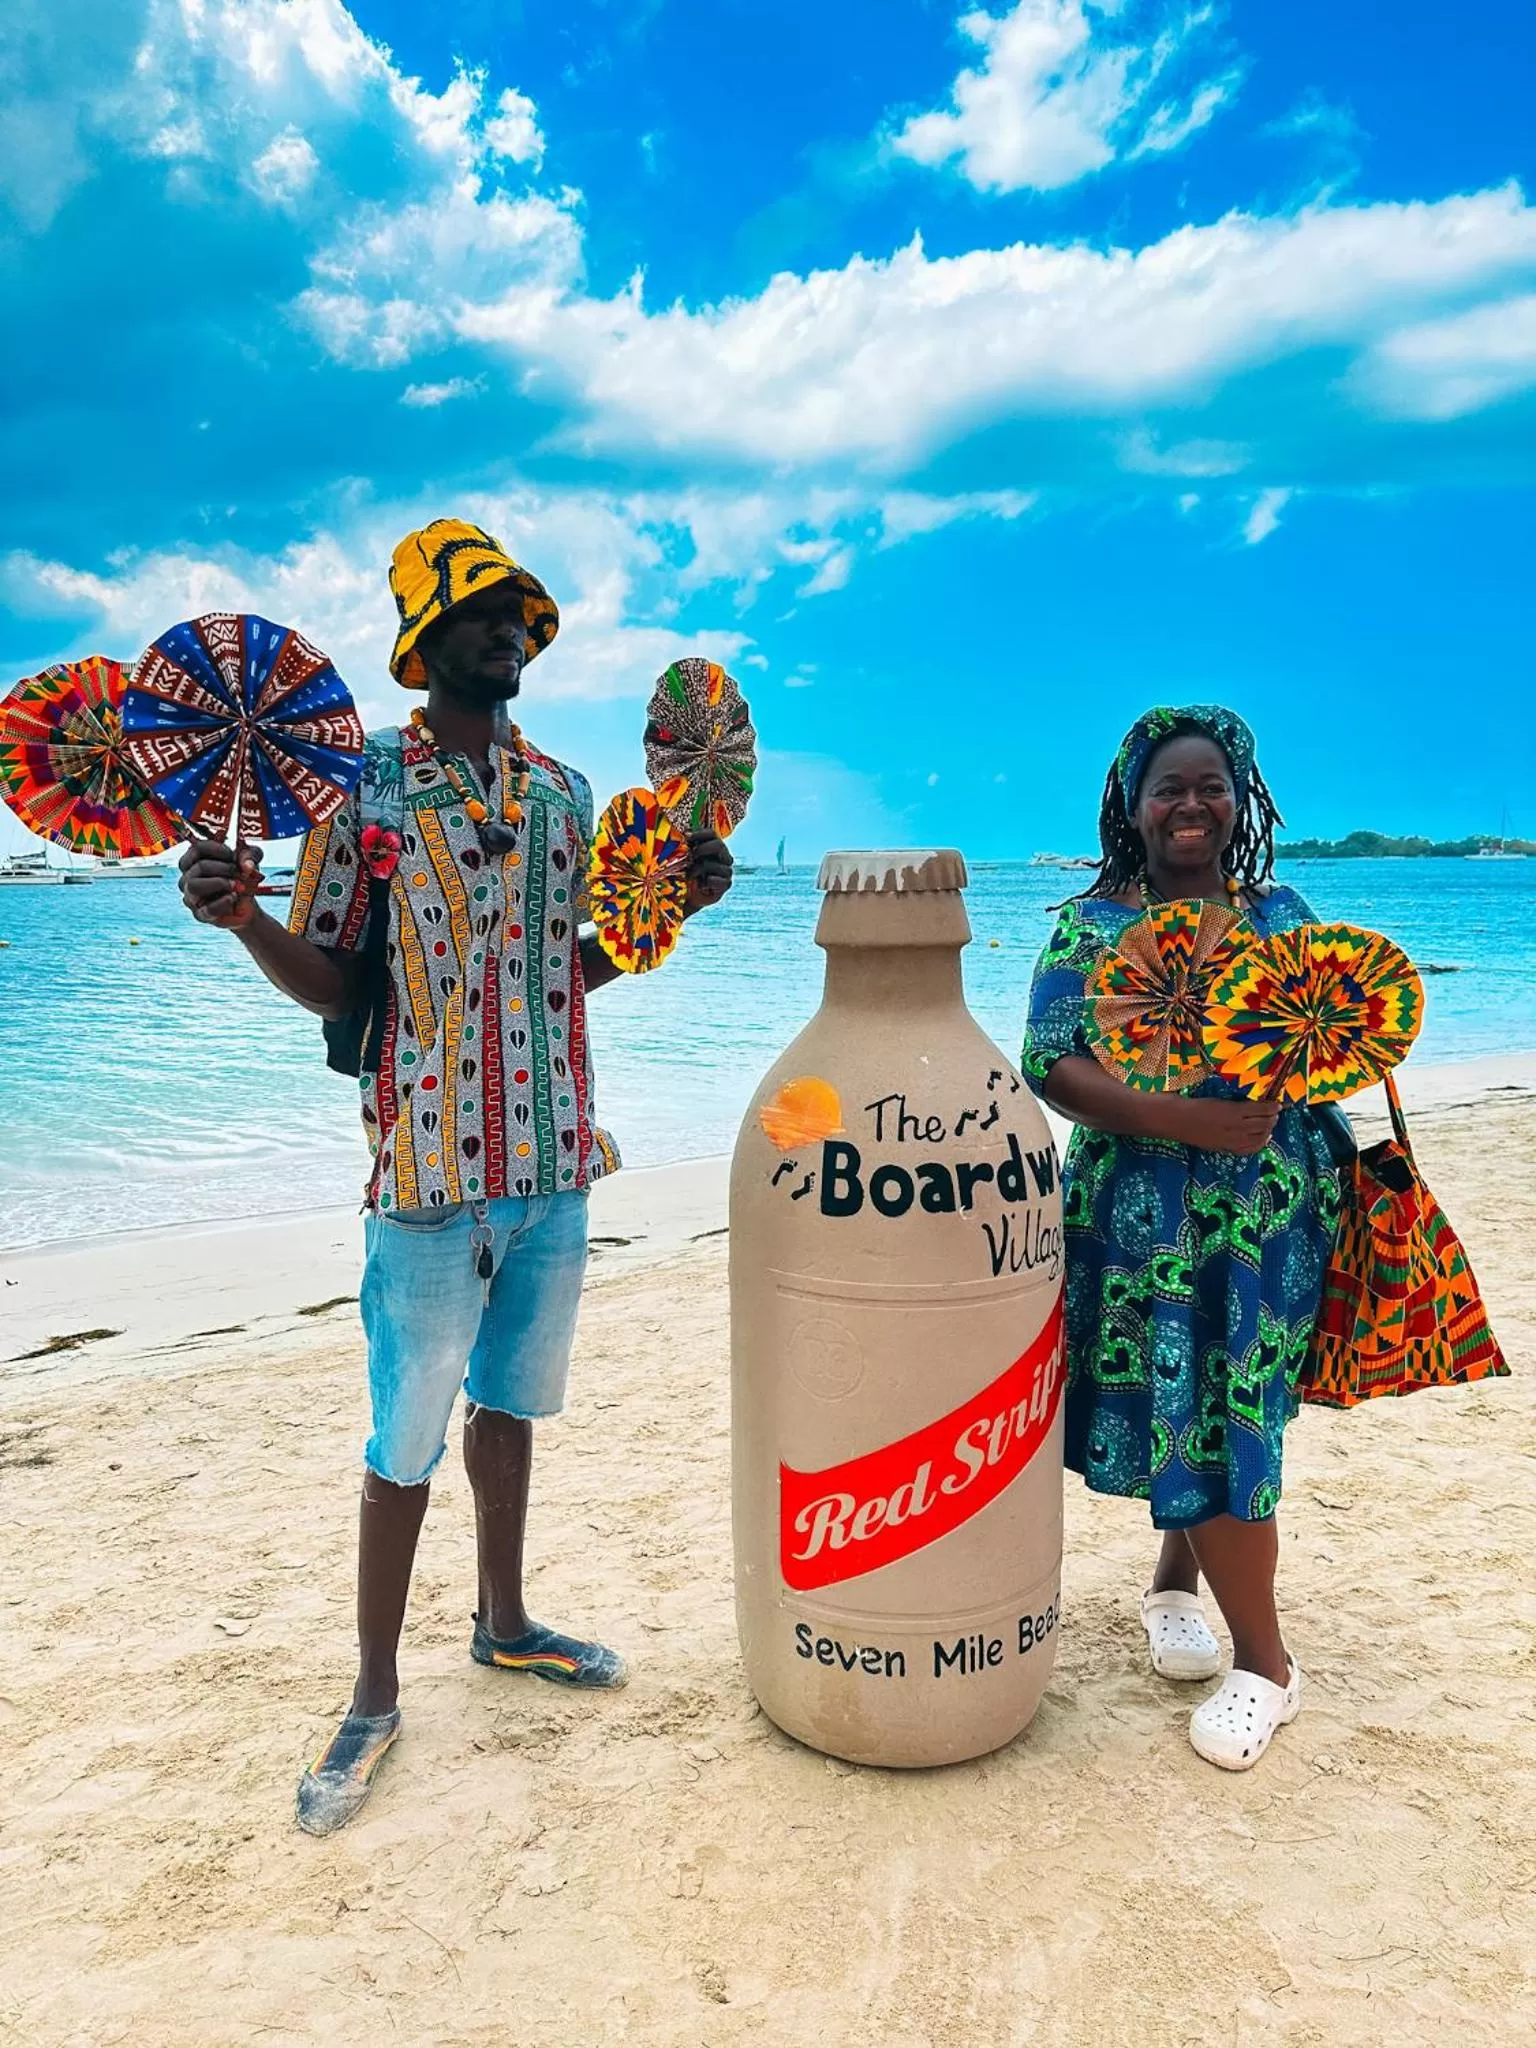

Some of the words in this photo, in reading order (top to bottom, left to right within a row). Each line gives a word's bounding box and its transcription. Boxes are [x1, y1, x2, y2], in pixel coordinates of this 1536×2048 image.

[864, 1093, 946, 1142] The
[820, 1133, 1063, 1217] Boardw
[981, 1207, 1063, 1281] Villag
[791, 1461, 937, 1561] Red
[795, 1623, 906, 1678] Seven
[933, 1633, 1004, 1678] Mile
